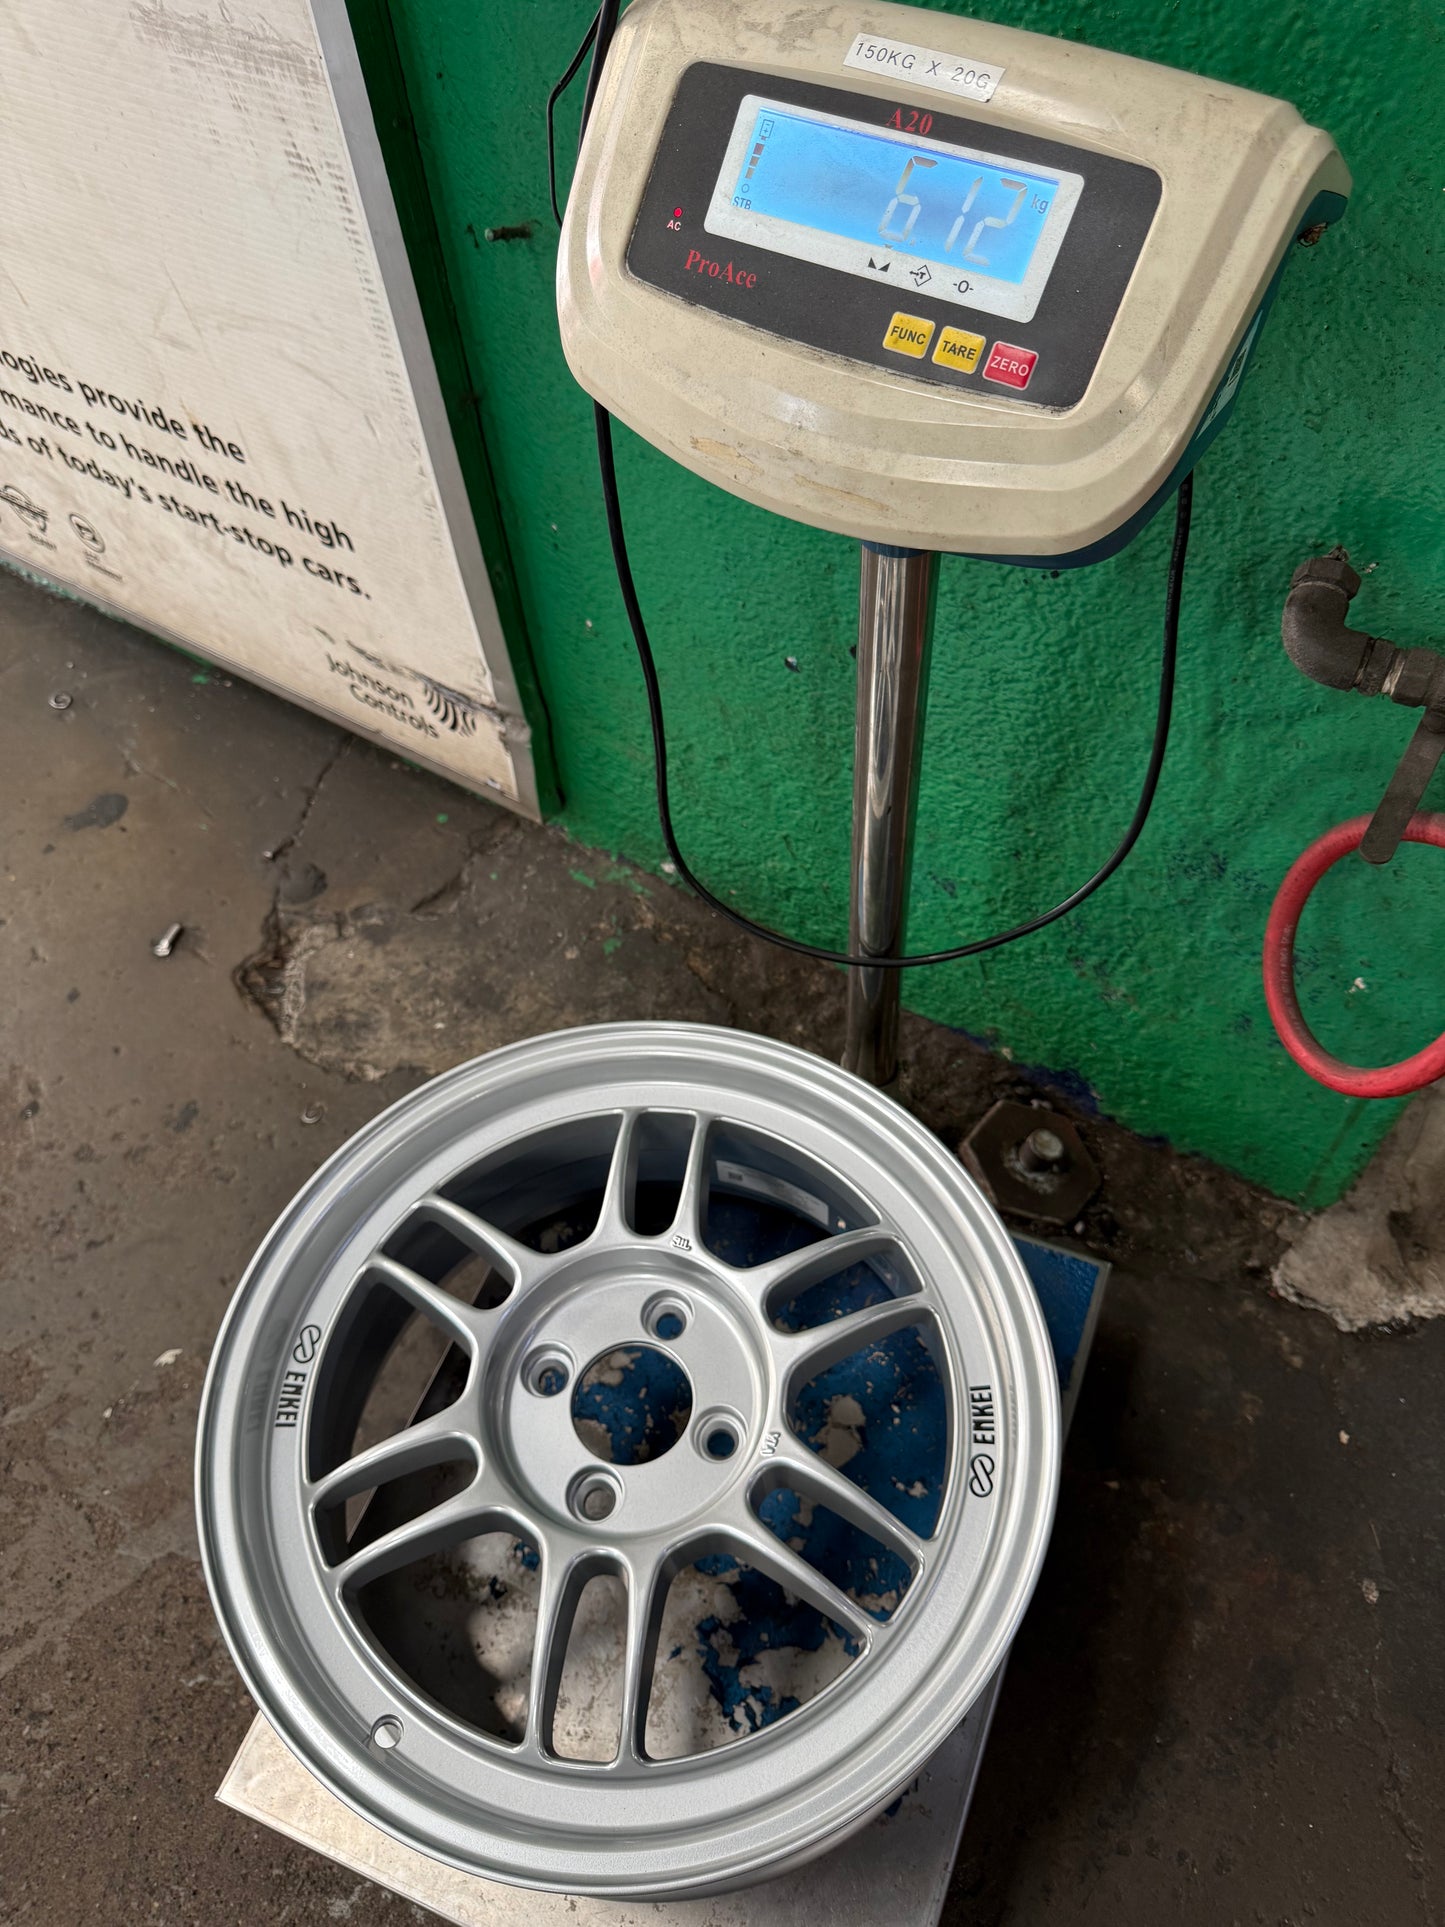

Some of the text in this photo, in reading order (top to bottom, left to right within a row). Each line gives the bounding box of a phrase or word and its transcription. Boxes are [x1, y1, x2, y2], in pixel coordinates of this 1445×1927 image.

[856, 42, 991, 89] 150KG X 20G
[885, 108, 934, 136] A20
[733, 196, 752, 210] STB
[1030, 194, 1049, 213] kg
[667, 220, 682, 231] AC
[684, 249, 757, 289] ProAce
[890, 325, 926, 345] FUNC
[942, 340, 977, 361] TARE
[990, 355, 1029, 377] ZERO
[77, 380, 188, 441] provide
[192, 423, 246, 464] the
[85, 421, 117, 450] to
[119, 432, 219, 495] handle
[223, 480, 277, 520] the
[280, 500, 356, 553] high
[27, 437, 54, 461] of
[57, 446, 154, 504] today's
[158, 493, 295, 569] start-stop
[302, 556, 372, 600] cars.
[325, 653, 439, 739] Johnson Controls
[274, 1370, 308, 1428] ENKEI
[969, 1384, 996, 1445] ENKEI
